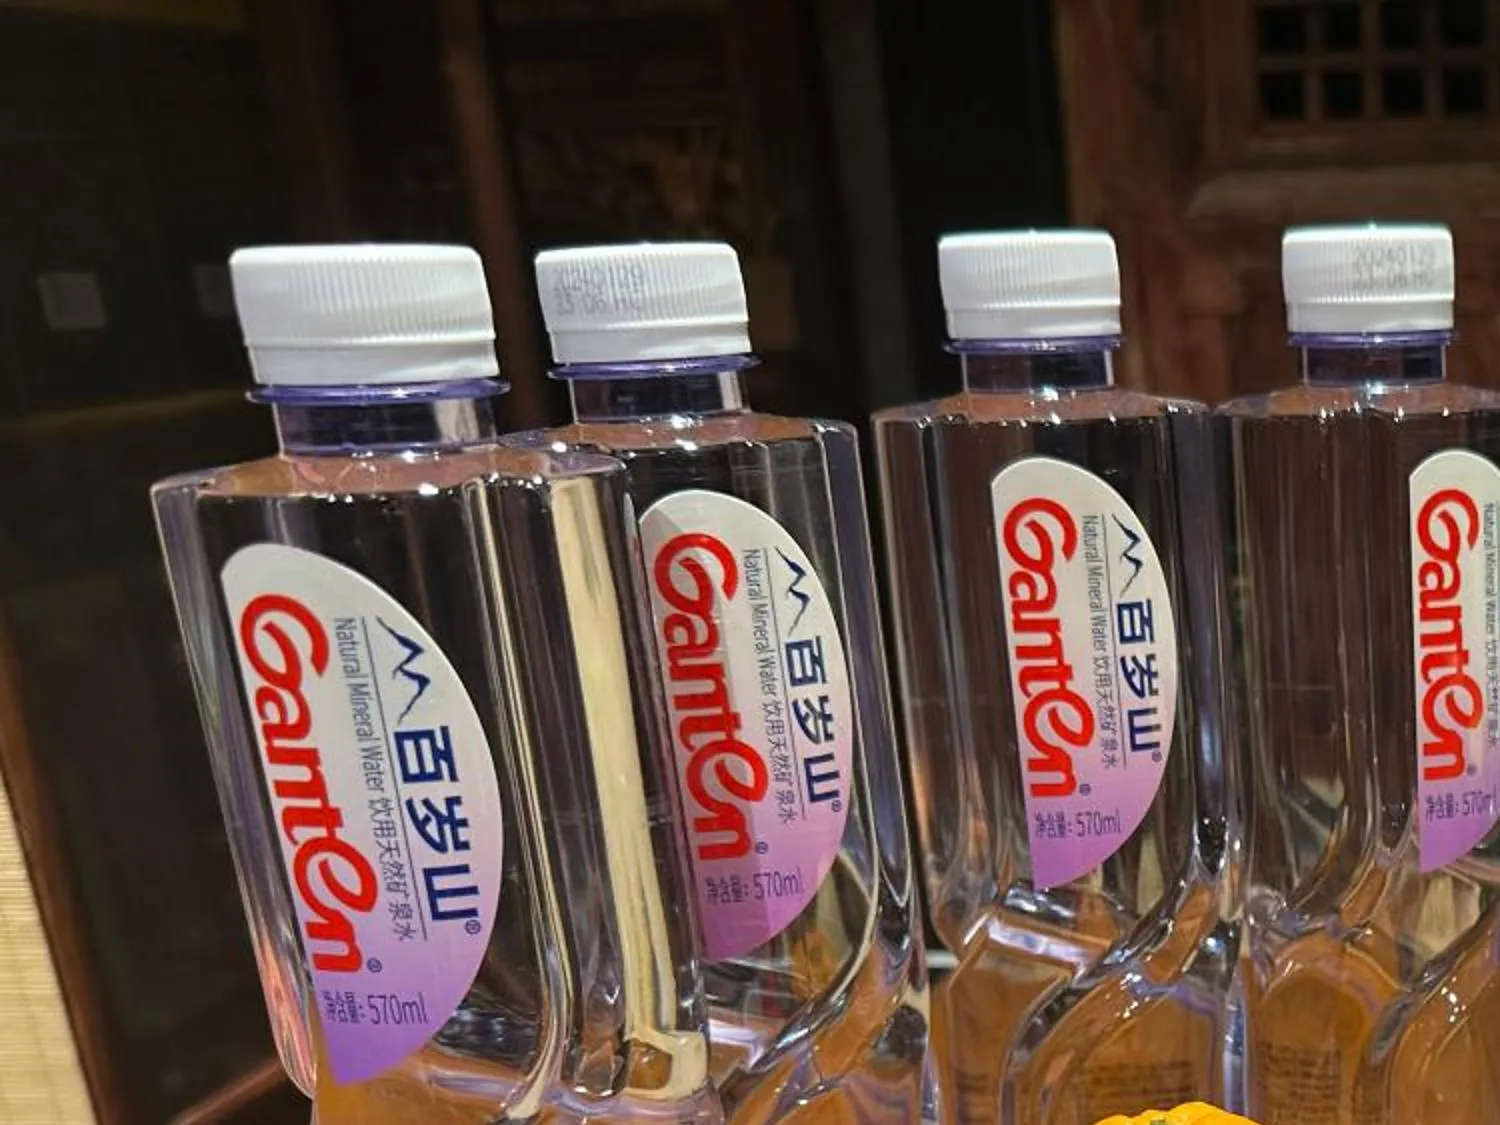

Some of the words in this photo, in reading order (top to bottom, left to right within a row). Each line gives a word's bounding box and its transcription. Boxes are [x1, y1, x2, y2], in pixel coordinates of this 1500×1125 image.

[1082, 514, 1104, 563] Natural
[743, 549, 767, 602] Natural
[1086, 564, 1107, 612] Mineral
[333, 617, 361, 681] Natural
[751, 602, 772, 657] Mineral
[1003, 497, 1095, 797] Ganten
[1090, 611, 1111, 654] Water
[1417, 488, 1484, 781] Ganten
[653, 533, 769, 861] Ganten
[757, 653, 779, 698] Water
[1116, 598, 1161, 753] 百岁山
[346, 682, 374, 748] Mineral
[784, 636, 841, 804] 百岁山
[240, 593, 378, 973] Ganten
[361, 746, 386, 792] Water
[394, 725, 481, 921] 百岁山
[1076, 808, 1121, 838] 570ml
[752, 866, 805, 900] 570ml
[367, 991, 429, 1025] 570ml
